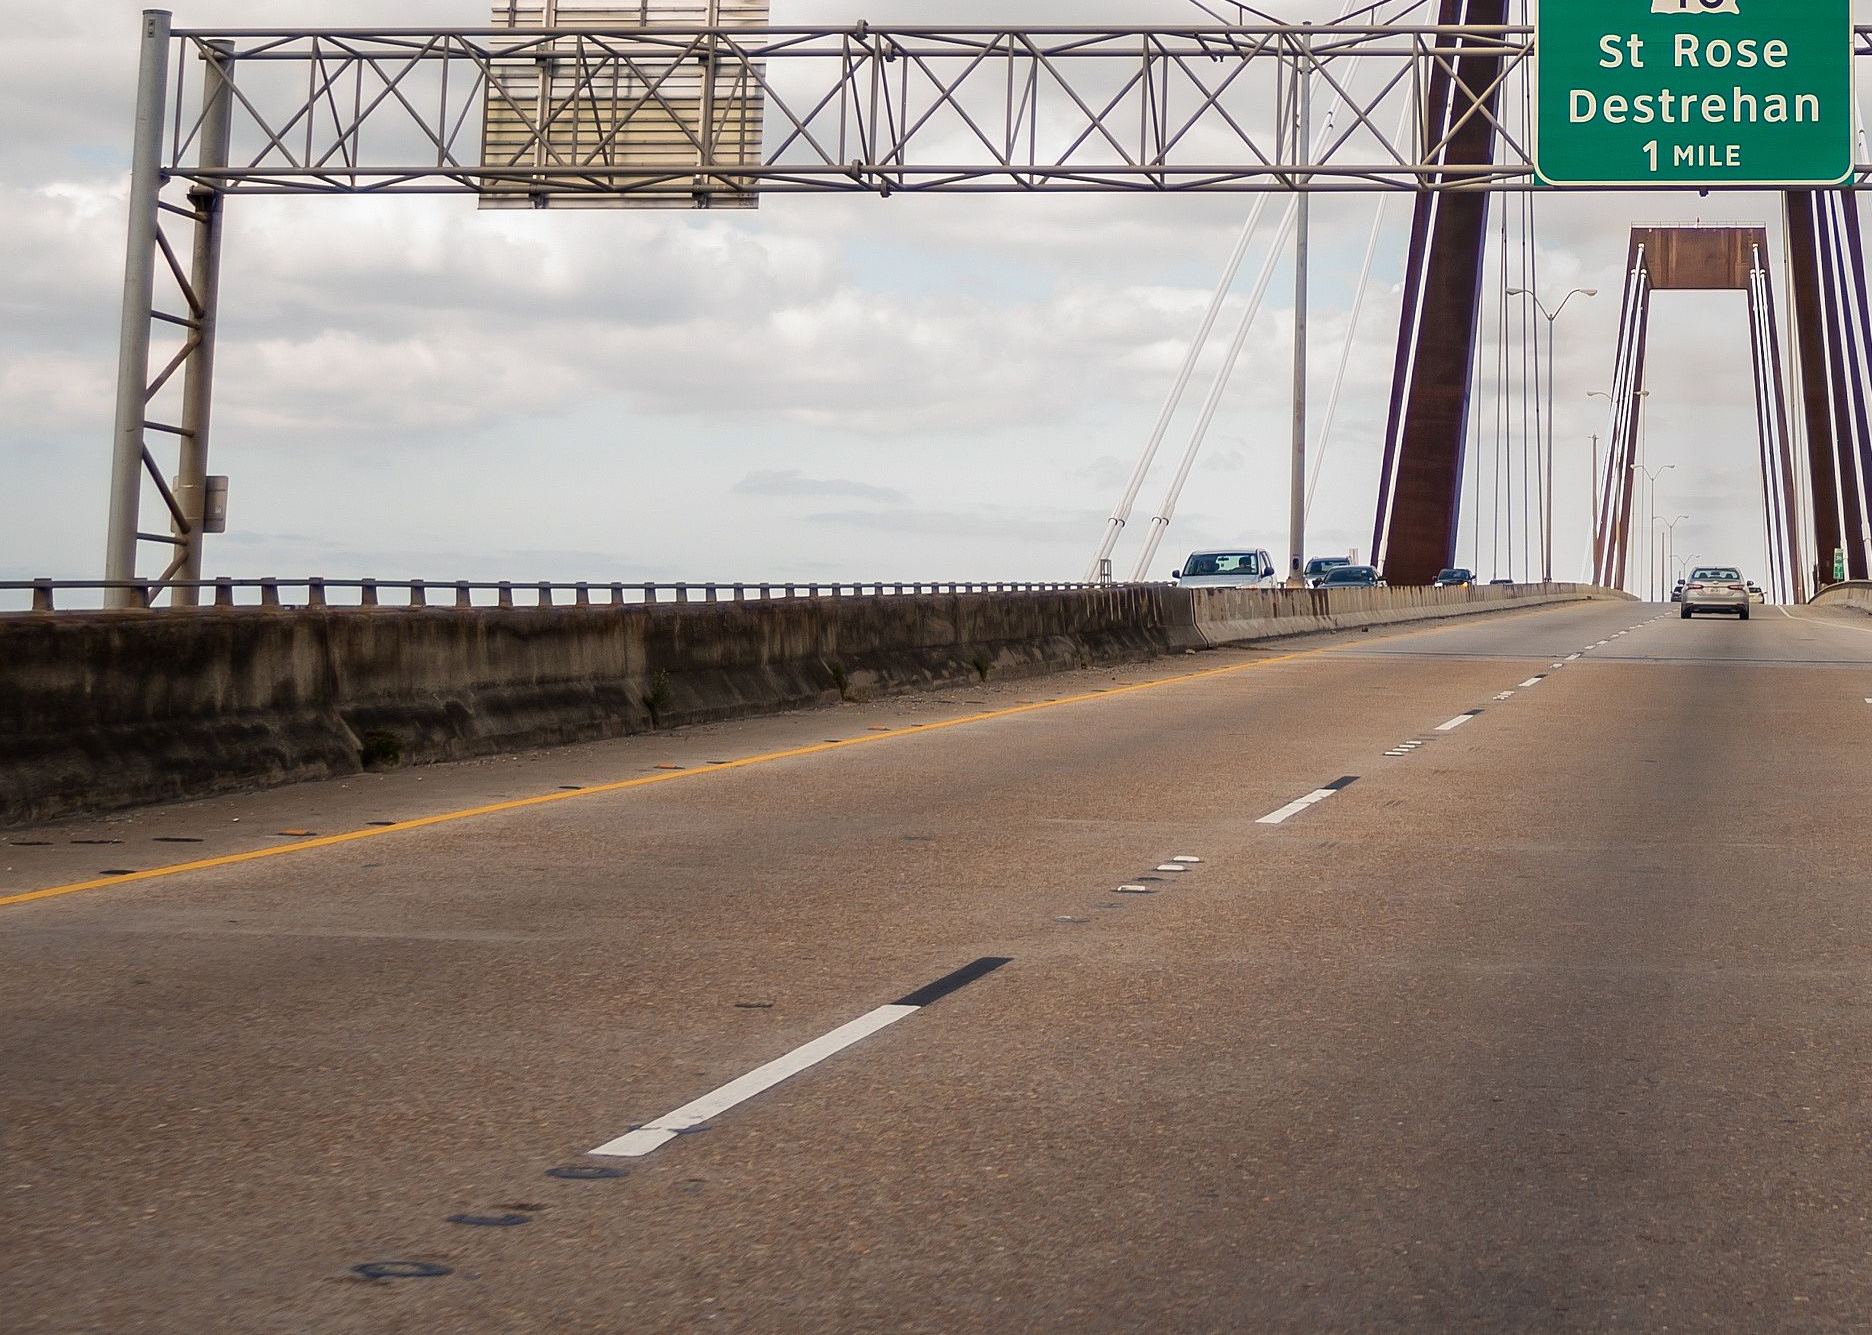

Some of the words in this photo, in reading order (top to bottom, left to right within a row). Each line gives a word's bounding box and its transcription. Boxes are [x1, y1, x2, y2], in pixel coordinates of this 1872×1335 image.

[1599, 34, 1644, 68] St
[1673, 33, 1789, 68] Rose
[1569, 86, 1820, 124] Destrehan
[1642, 140, 1658, 172] 1
[1673, 145, 1741, 167] MILE
